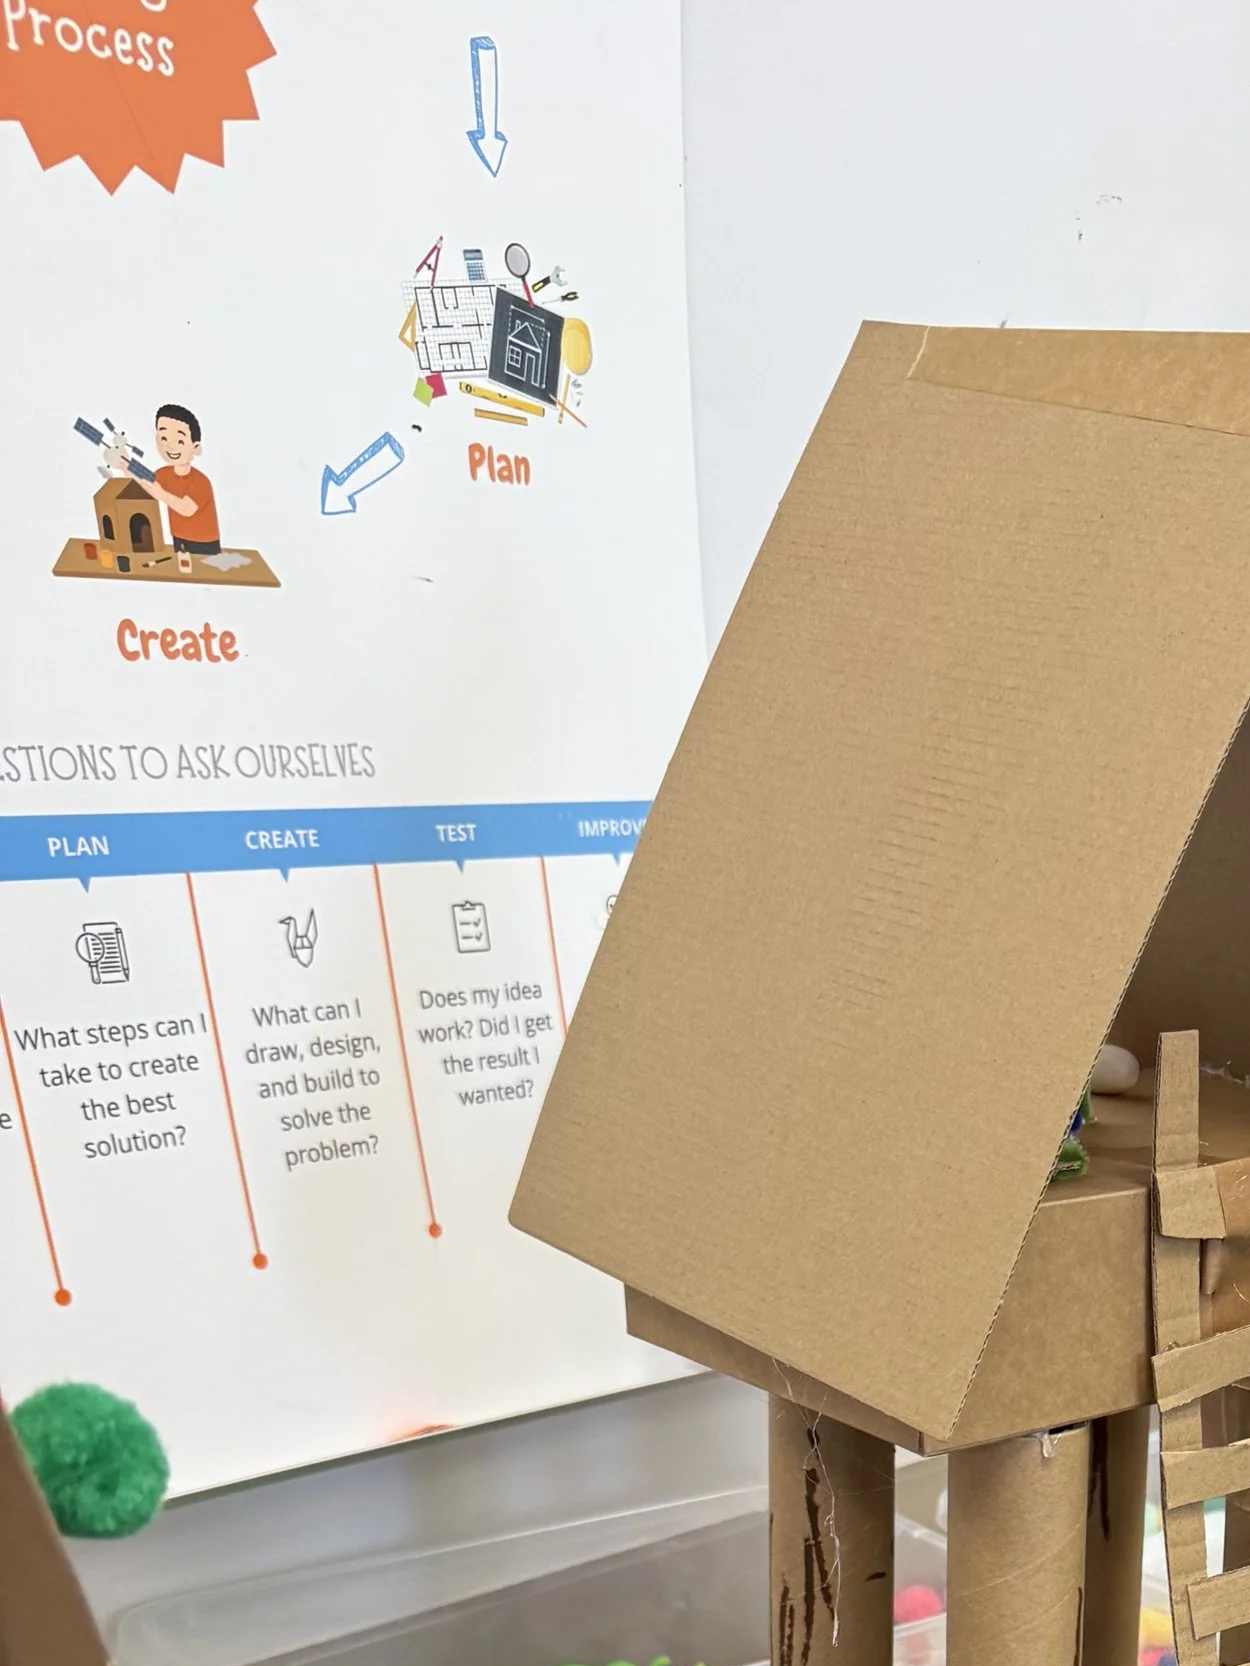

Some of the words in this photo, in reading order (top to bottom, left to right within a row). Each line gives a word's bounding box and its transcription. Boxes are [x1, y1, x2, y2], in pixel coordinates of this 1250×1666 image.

[3, 0, 175, 77] Process
[468, 443, 531, 486] Plan
[116, 618, 239, 663] Create
[0, 744, 117, 782] STIONS
[120, 744, 168, 780] TO
[176, 744, 232, 780] ASK
[235, 742, 376, 779] OURSELVES
[245, 829, 320, 850] CREATE
[435, 823, 477, 843] TEST
[578, 817, 647, 838] IMPROV
[47, 835, 110, 857] PLAN
[419, 990, 468, 1010] Does
[472, 989, 500, 1009] my
[505, 981, 542, 1001] idea
[252, 1005, 310, 1027] What
[315, 1003, 350, 1021] can
[355, 998, 362, 1018] I
[14, 1026, 81, 1051] What
[86, 1022, 148, 1047] steps
[155, 1018, 195, 1037] can
[200, 1013, 207, 1033] I
[418, 1020, 473, 1044] work?
[479, 1015, 510, 1038] Did
[514, 1015, 521, 1034] I
[525, 1014, 554, 1038] get
[245, 1042, 304, 1064] draw,
[310, 1034, 381, 1058] design,
[442, 1055, 474, 1075] the
[478, 1046, 530, 1071] result
[534, 1046, 541, 1065] I
[39, 1063, 92, 1087] take
[97, 1062, 122, 1081] to
[129, 1054, 200, 1077] create
[259, 1074, 298, 1099] and
[304, 1068, 355, 1093] build
[359, 1068, 381, 1086] to
[81, 1098, 120, 1121] the
[125, 1092, 177, 1115] best
[458, 1079, 534, 1106] wanted?
[281, 1108, 334, 1132] solve
[338, 1102, 372, 1124] the
[84, 1126, 187, 1158] solution?
[285, 1135, 379, 1172] problem?
